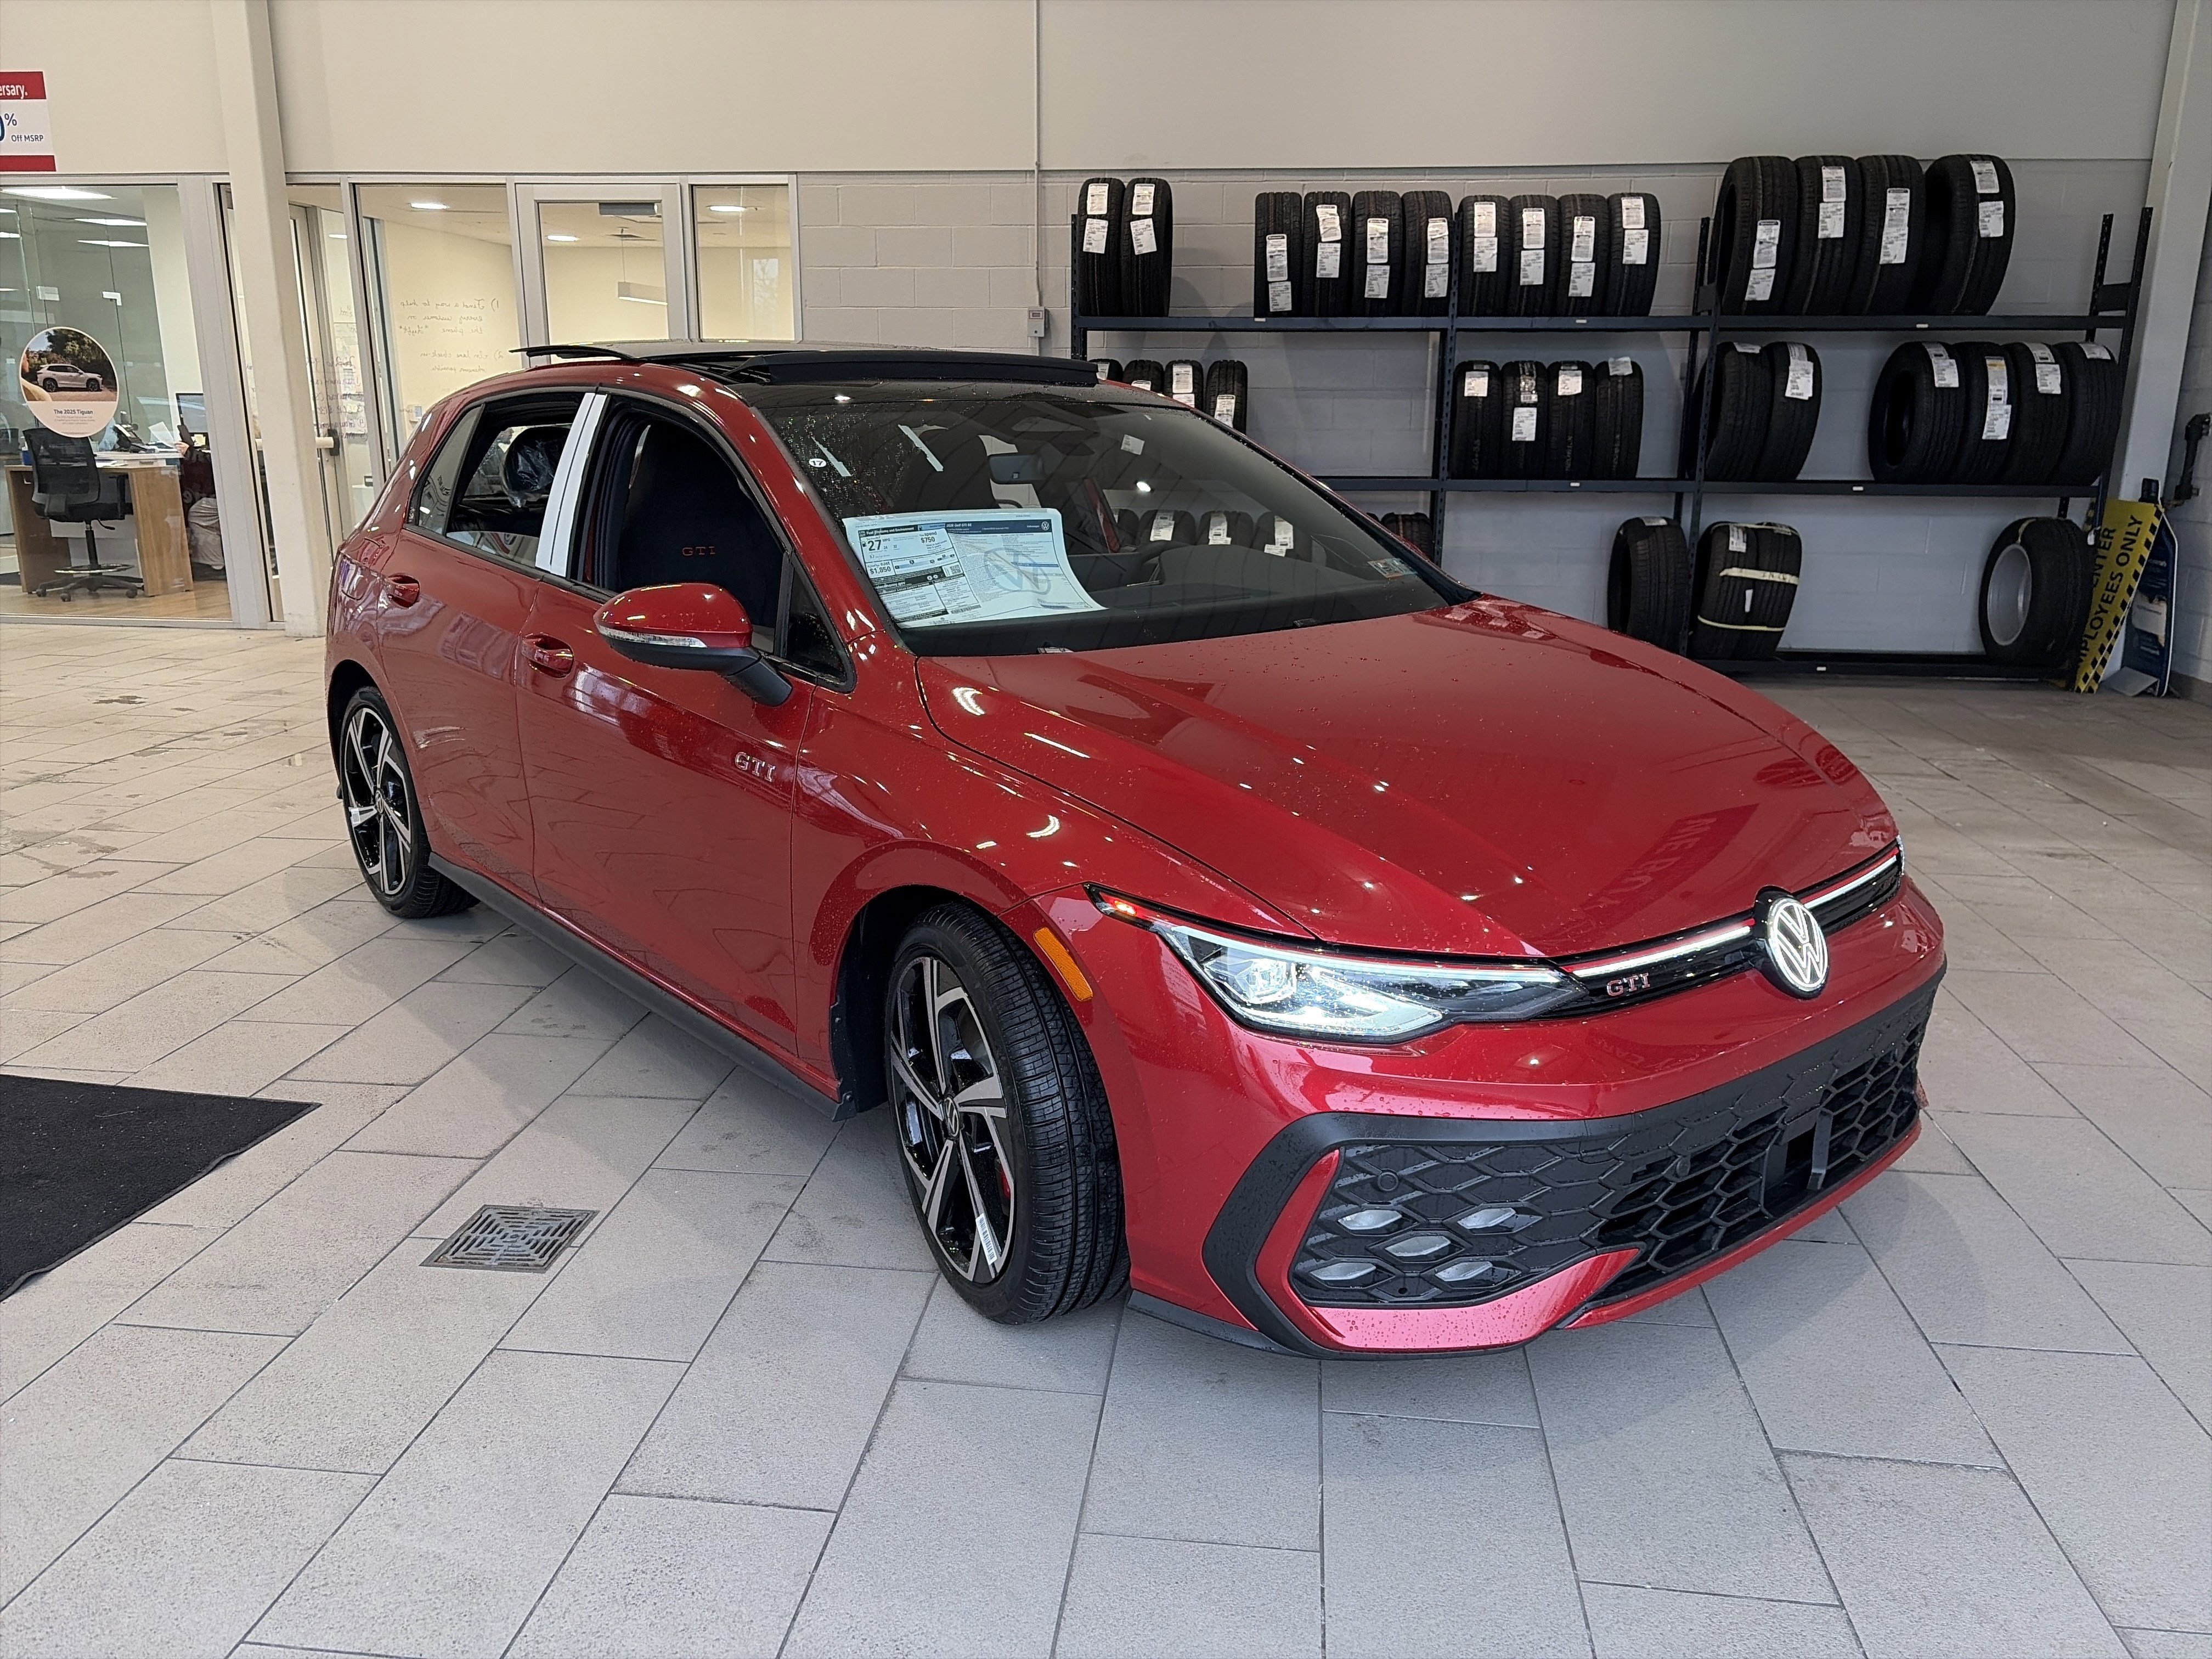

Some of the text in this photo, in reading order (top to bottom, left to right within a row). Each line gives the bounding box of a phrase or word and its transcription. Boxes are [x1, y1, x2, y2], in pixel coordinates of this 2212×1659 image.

[682, 546, 716, 556] GTI
[867, 539, 881, 551] 27
[2078, 515, 2143, 663] PLOYEES ONLY
[735, 752, 776, 782] GTI
[1606, 972, 1650, 996] GTI
